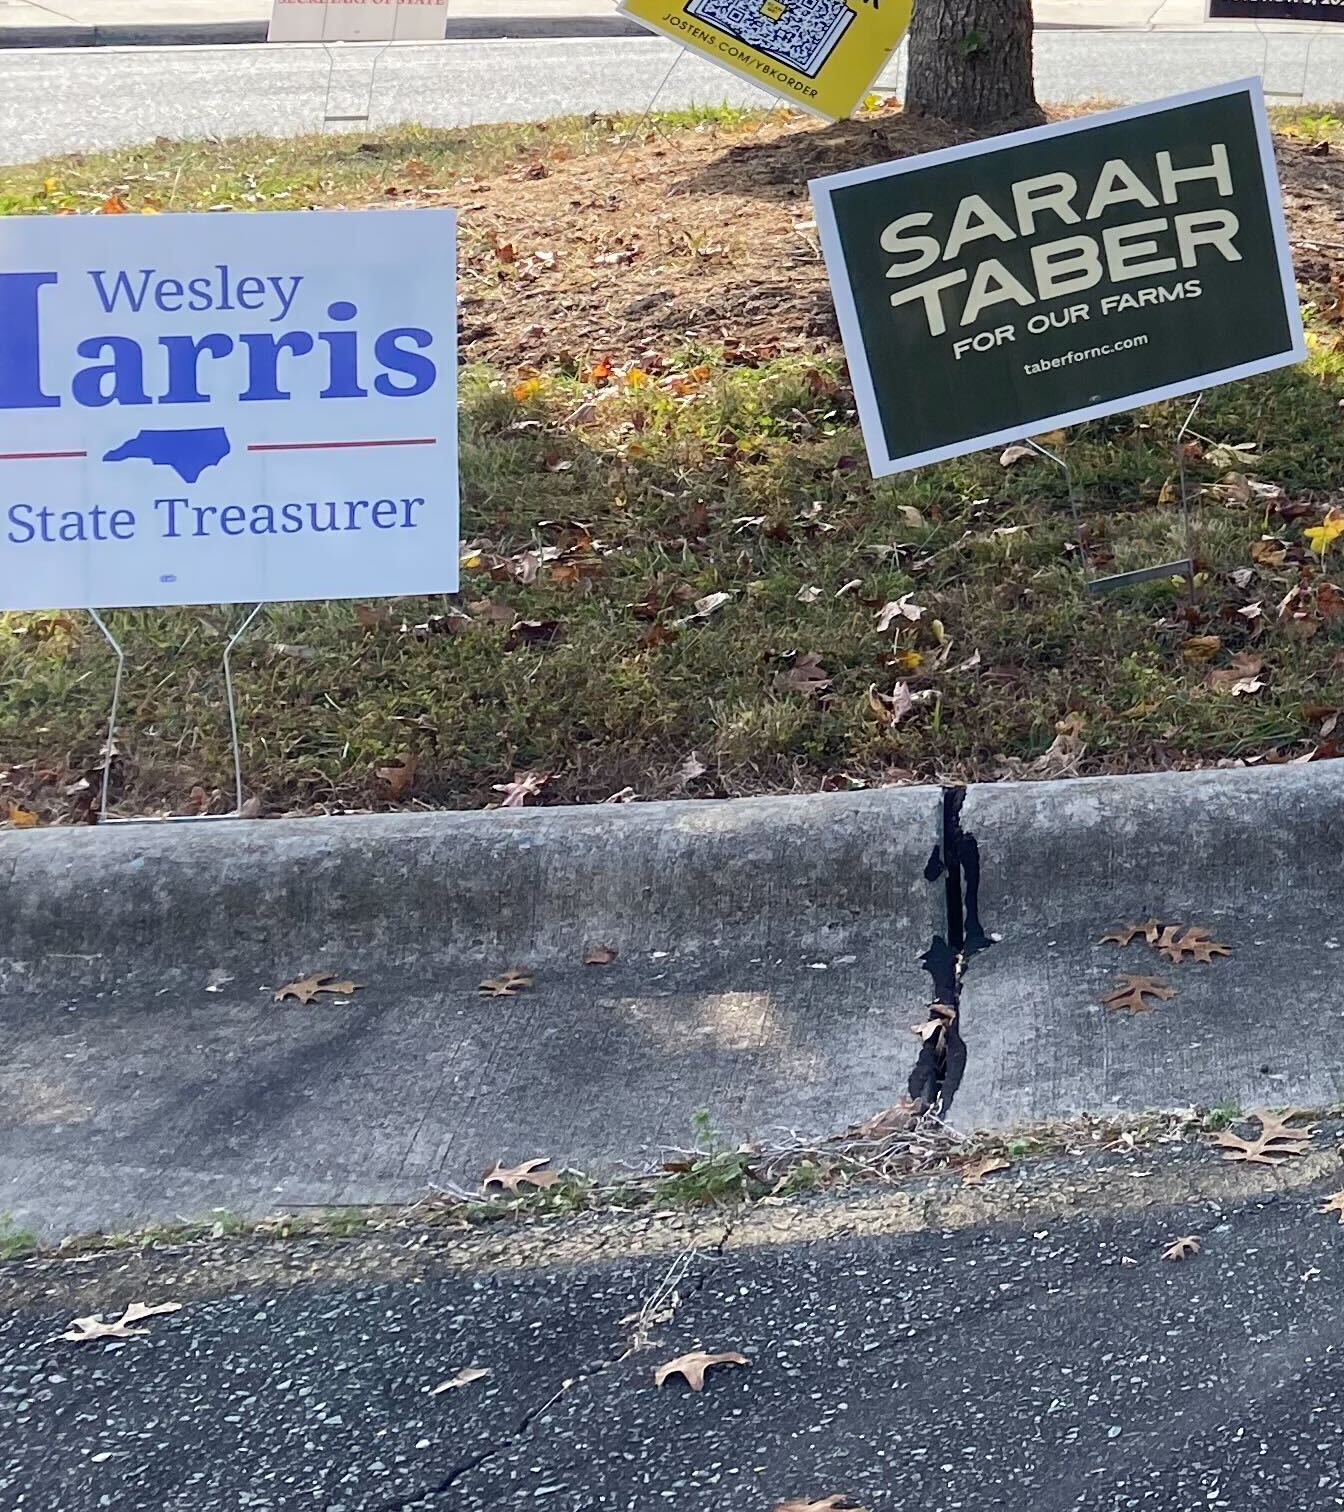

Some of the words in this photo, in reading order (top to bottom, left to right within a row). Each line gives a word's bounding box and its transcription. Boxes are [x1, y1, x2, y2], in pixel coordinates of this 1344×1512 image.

[662, 13, 818, 99] JOSTENS.COM/YBKORDER
[878, 143, 1233, 278] SARAH
[88, 265, 304, 321] Wesley
[890, 208, 1242, 337] TABER
[952, 324, 1016, 359] FOR
[1026, 303, 1091, 337] OUR
[1100, 279, 1202, 316] FARMS
[1023, 333, 1149, 376] taberfornc.com
[8, 503, 136, 544] State
[154, 496, 425, 538] Treasurer
